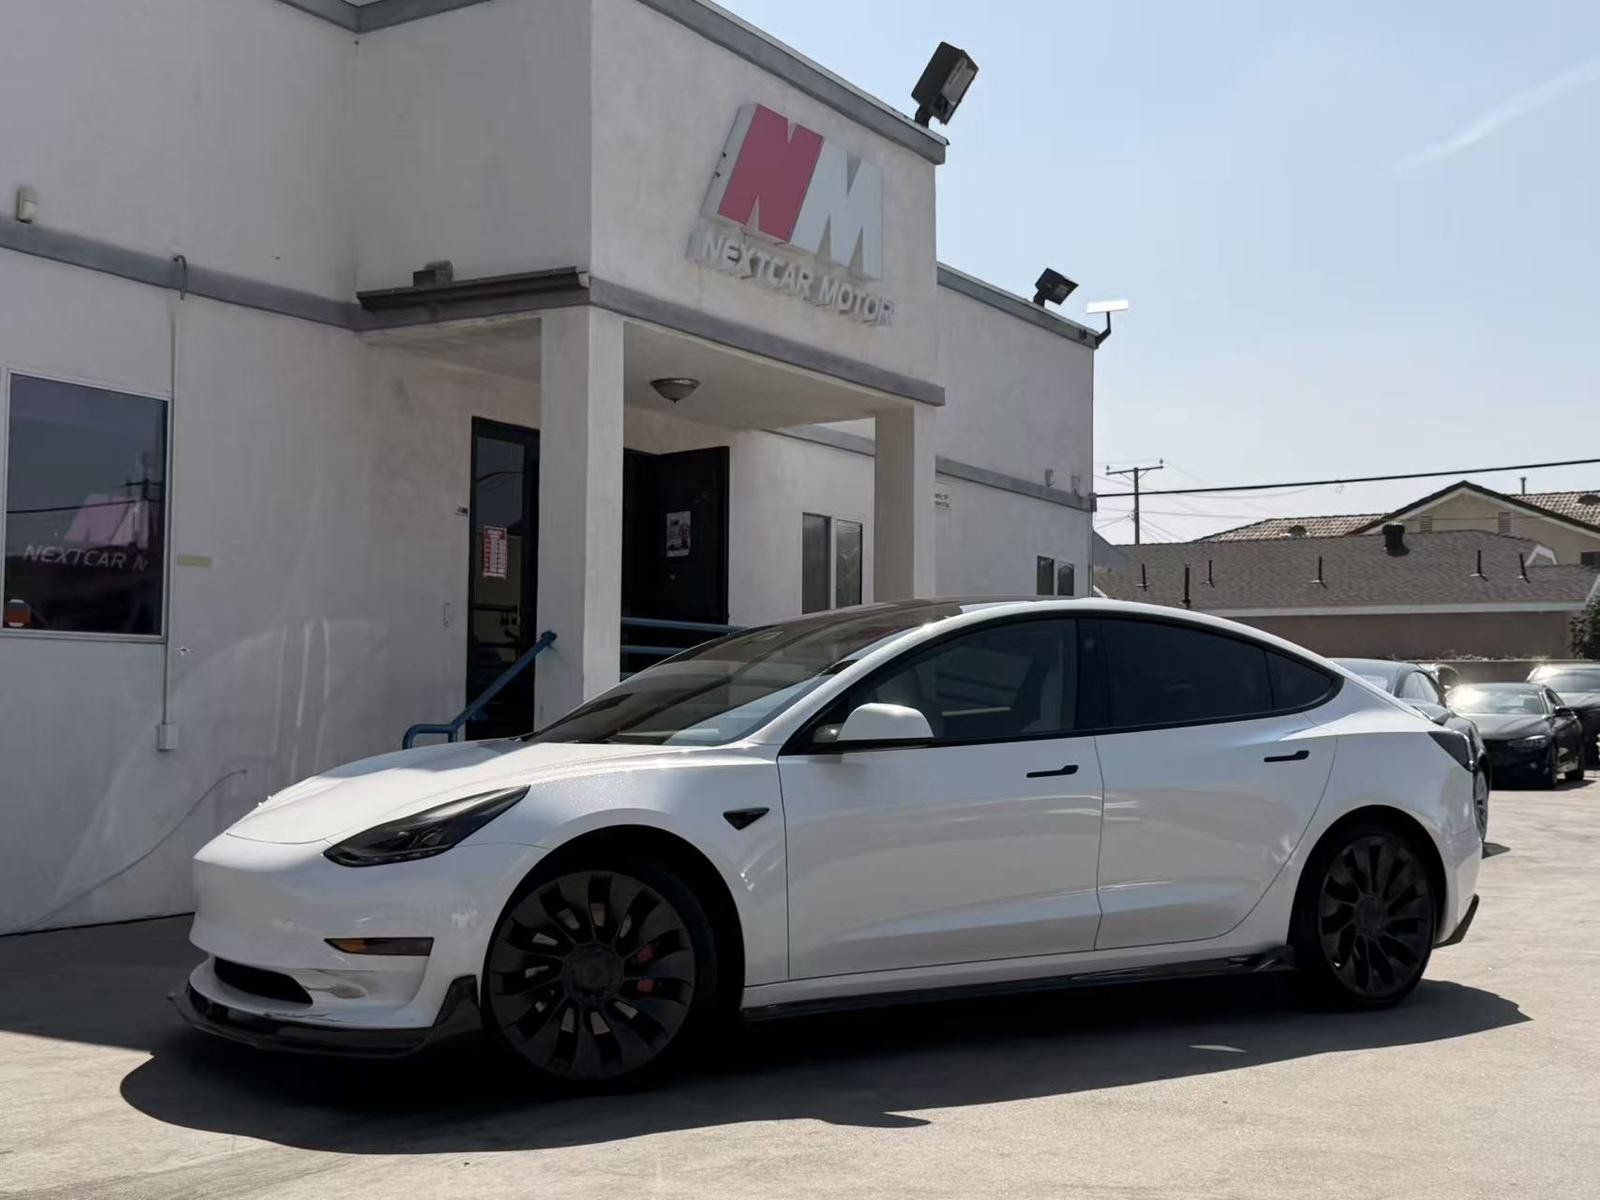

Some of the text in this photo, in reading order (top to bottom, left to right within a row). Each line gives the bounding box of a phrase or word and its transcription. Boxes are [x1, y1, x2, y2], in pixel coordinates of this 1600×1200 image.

[697, 228, 895, 326] NEXTCAR MOTOR
[22, 543, 127, 570] NEXTCAR
